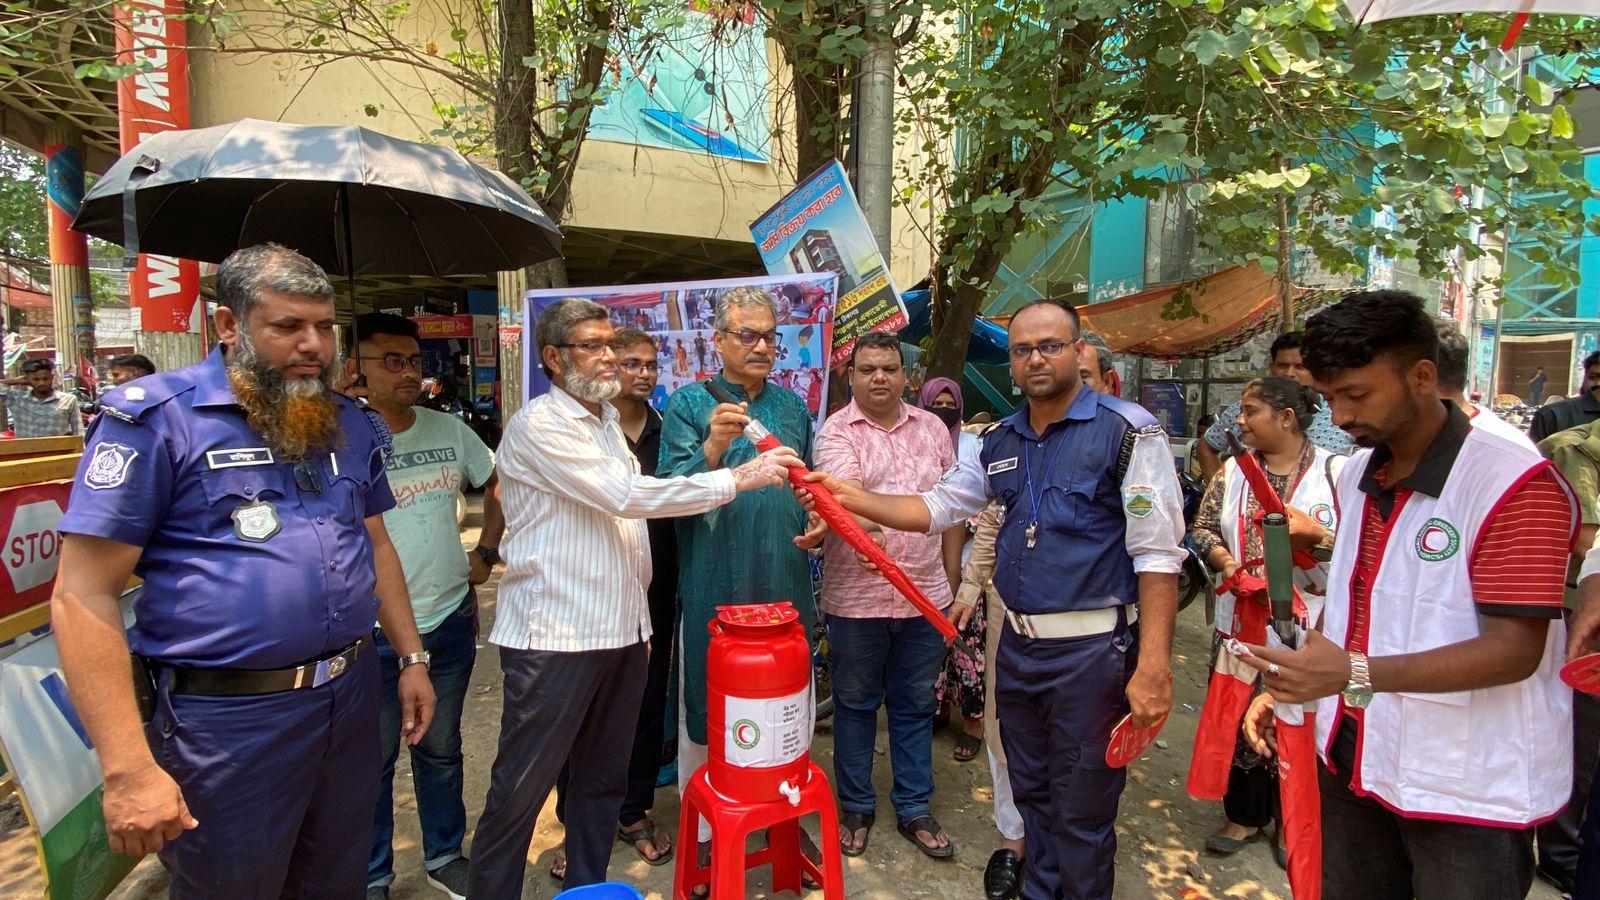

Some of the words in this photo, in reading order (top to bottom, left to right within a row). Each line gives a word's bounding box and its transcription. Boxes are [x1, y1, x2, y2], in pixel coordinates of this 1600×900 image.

[760, 230, 781, 253] জমি
[779, 212, 806, 240] বিক্রয়
[804, 197, 825, 219] করা
[824, 183, 845, 206] হবে
[386, 455, 408, 469] CK
[412, 448, 455, 465] OLIVE
[393, 464, 460, 508] iginals
